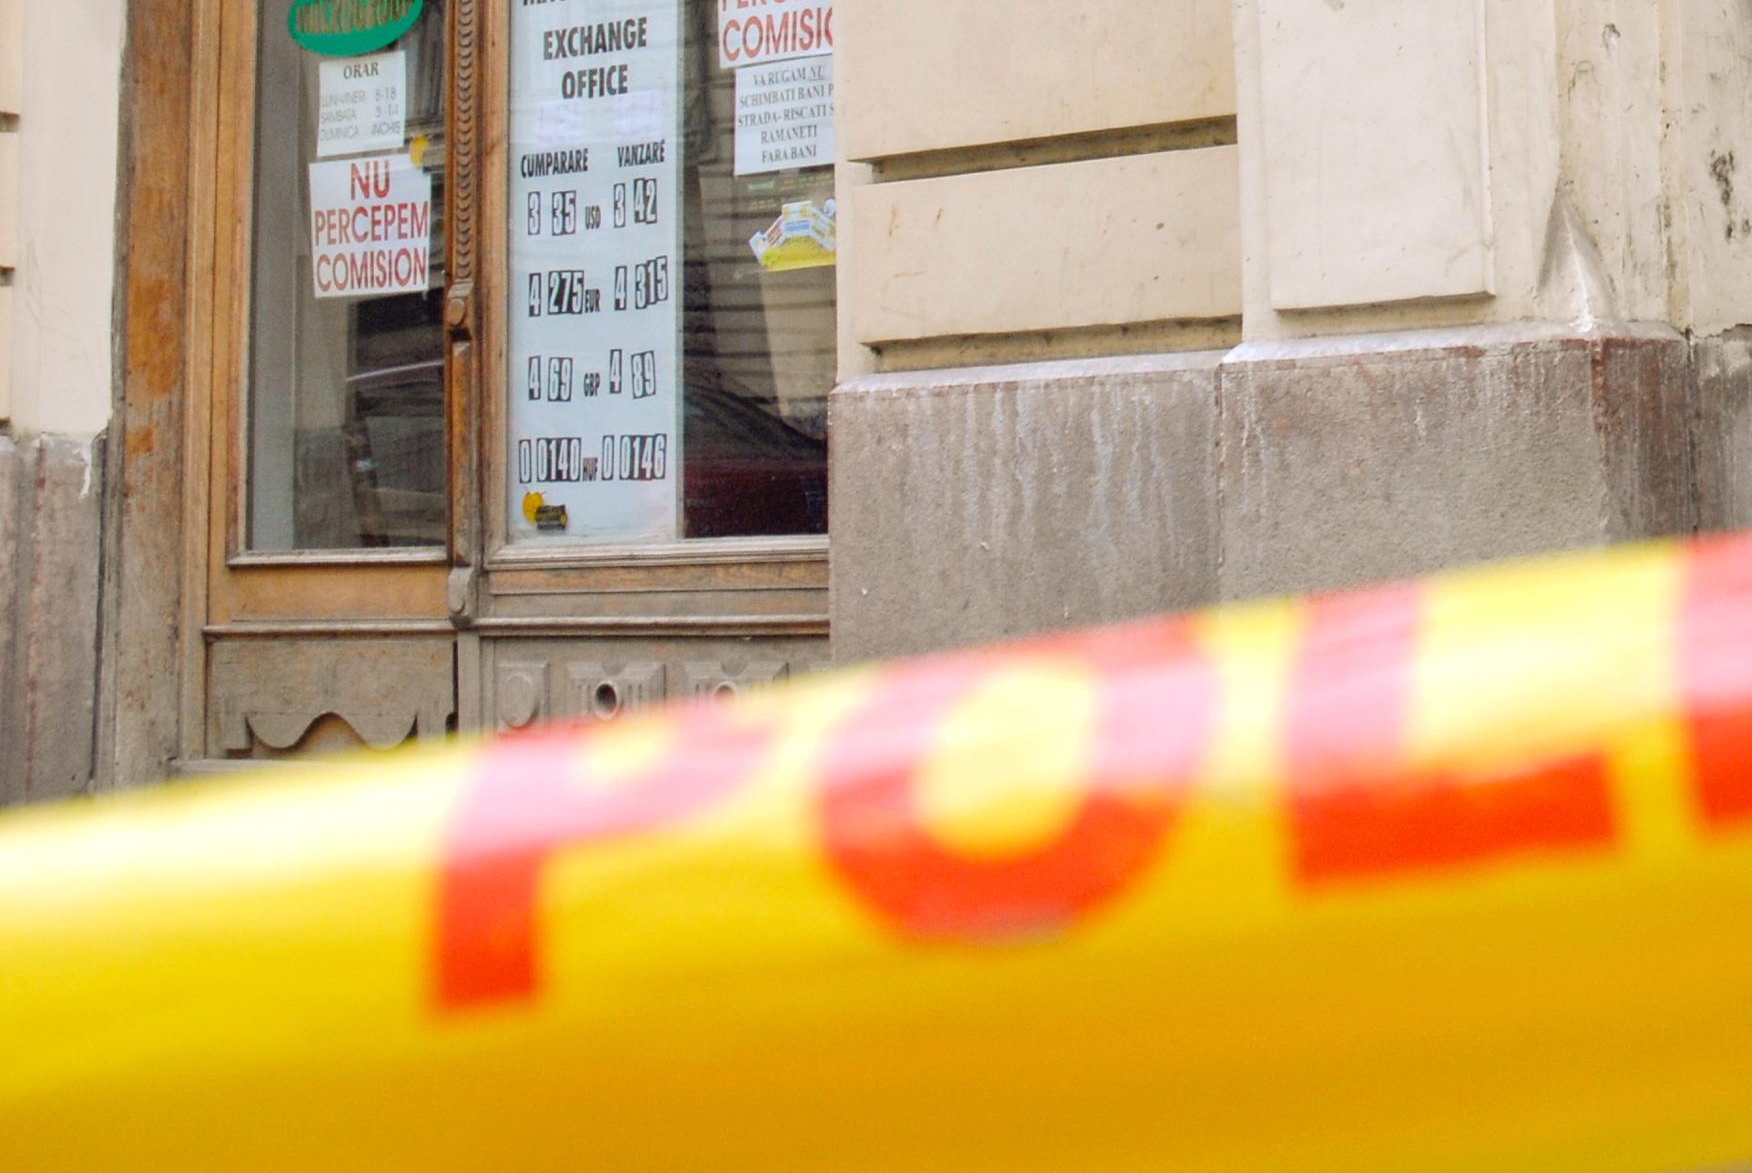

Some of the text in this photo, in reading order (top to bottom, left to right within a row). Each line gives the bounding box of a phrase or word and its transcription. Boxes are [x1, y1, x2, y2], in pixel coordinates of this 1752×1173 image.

[543, 17, 648, 61] EXCHANGE
[343, 62, 380, 80] ORAR
[561, 64, 629, 99] OFFICE
[740, 88, 796, 107] SCHIMBATI
[798, 84, 825, 100] BANI
[783, 105, 827, 122] RISCATI
[760, 125, 817, 144] RAMANETI
[762, 145, 817, 163] FARA BANI
[521, 139, 665, 178] CUMPARARE VANZARE
[351, 159, 390, 200] NU
[315, 201, 429, 246] PERCEPEM
[528, 178, 657, 236] 3 35 USD 3 42
[317, 247, 427, 292] COMISION
[529, 255, 668, 317] 4 275 EUR 4 315
[528, 349, 656, 402] 4 69 GBP 4 89
[519, 439, 531, 483] 0
[536, 437, 582, 483] 0140
[601, 435, 614, 481] 0
[619, 433, 667, 481] 0146
